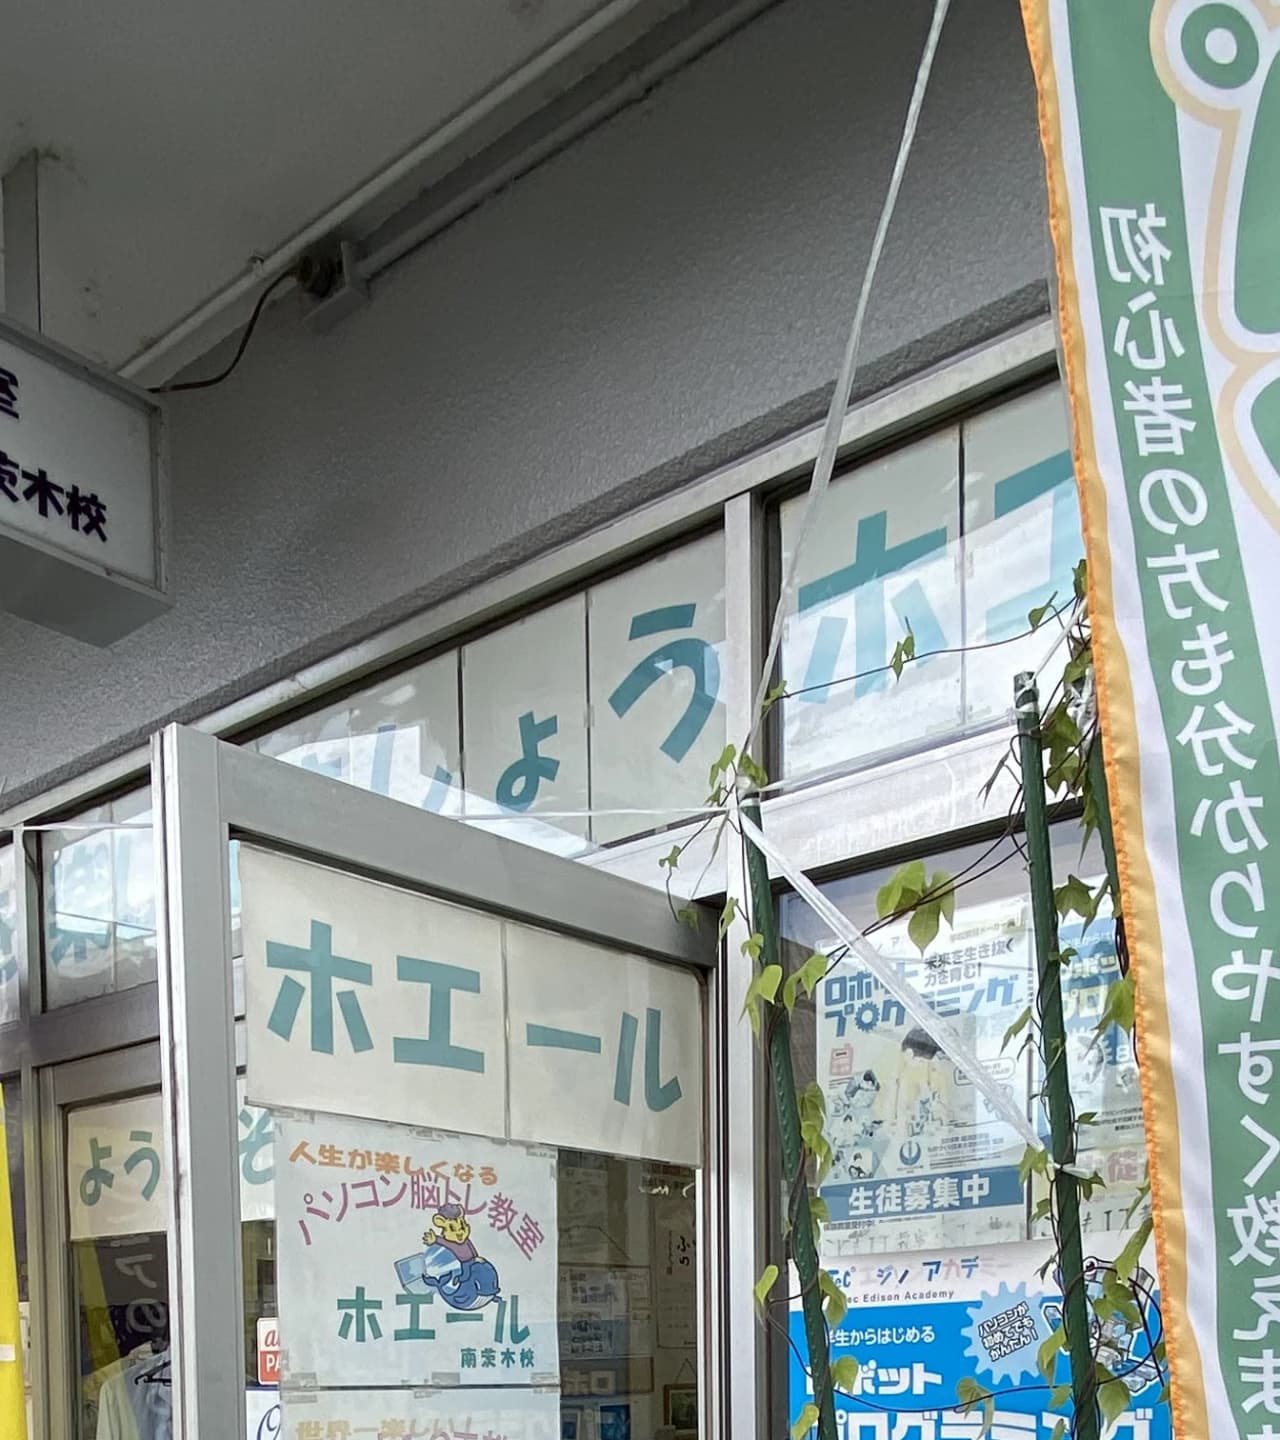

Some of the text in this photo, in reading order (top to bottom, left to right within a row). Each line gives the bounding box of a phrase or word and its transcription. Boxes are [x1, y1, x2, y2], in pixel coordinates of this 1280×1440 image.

[265, 919, 683, 1112] ホエール
[79, 1130, 161, 1207] よう
[288, 1140, 499, 1187] 人生が楽しくなる
[848, 1174, 991, 1216] 生徒募集中
[298, 1174, 546, 1261] パソコン脳トレ教室
[337, 1286, 531, 1345] ホエール
[863, 1289, 955, 1303] Edison Academy
[978, 1301, 1029, 1337] パソコンが
[982, 1317, 1035, 1349] 初めてでも
[460, 1347, 536, 1370] 南茨木校
